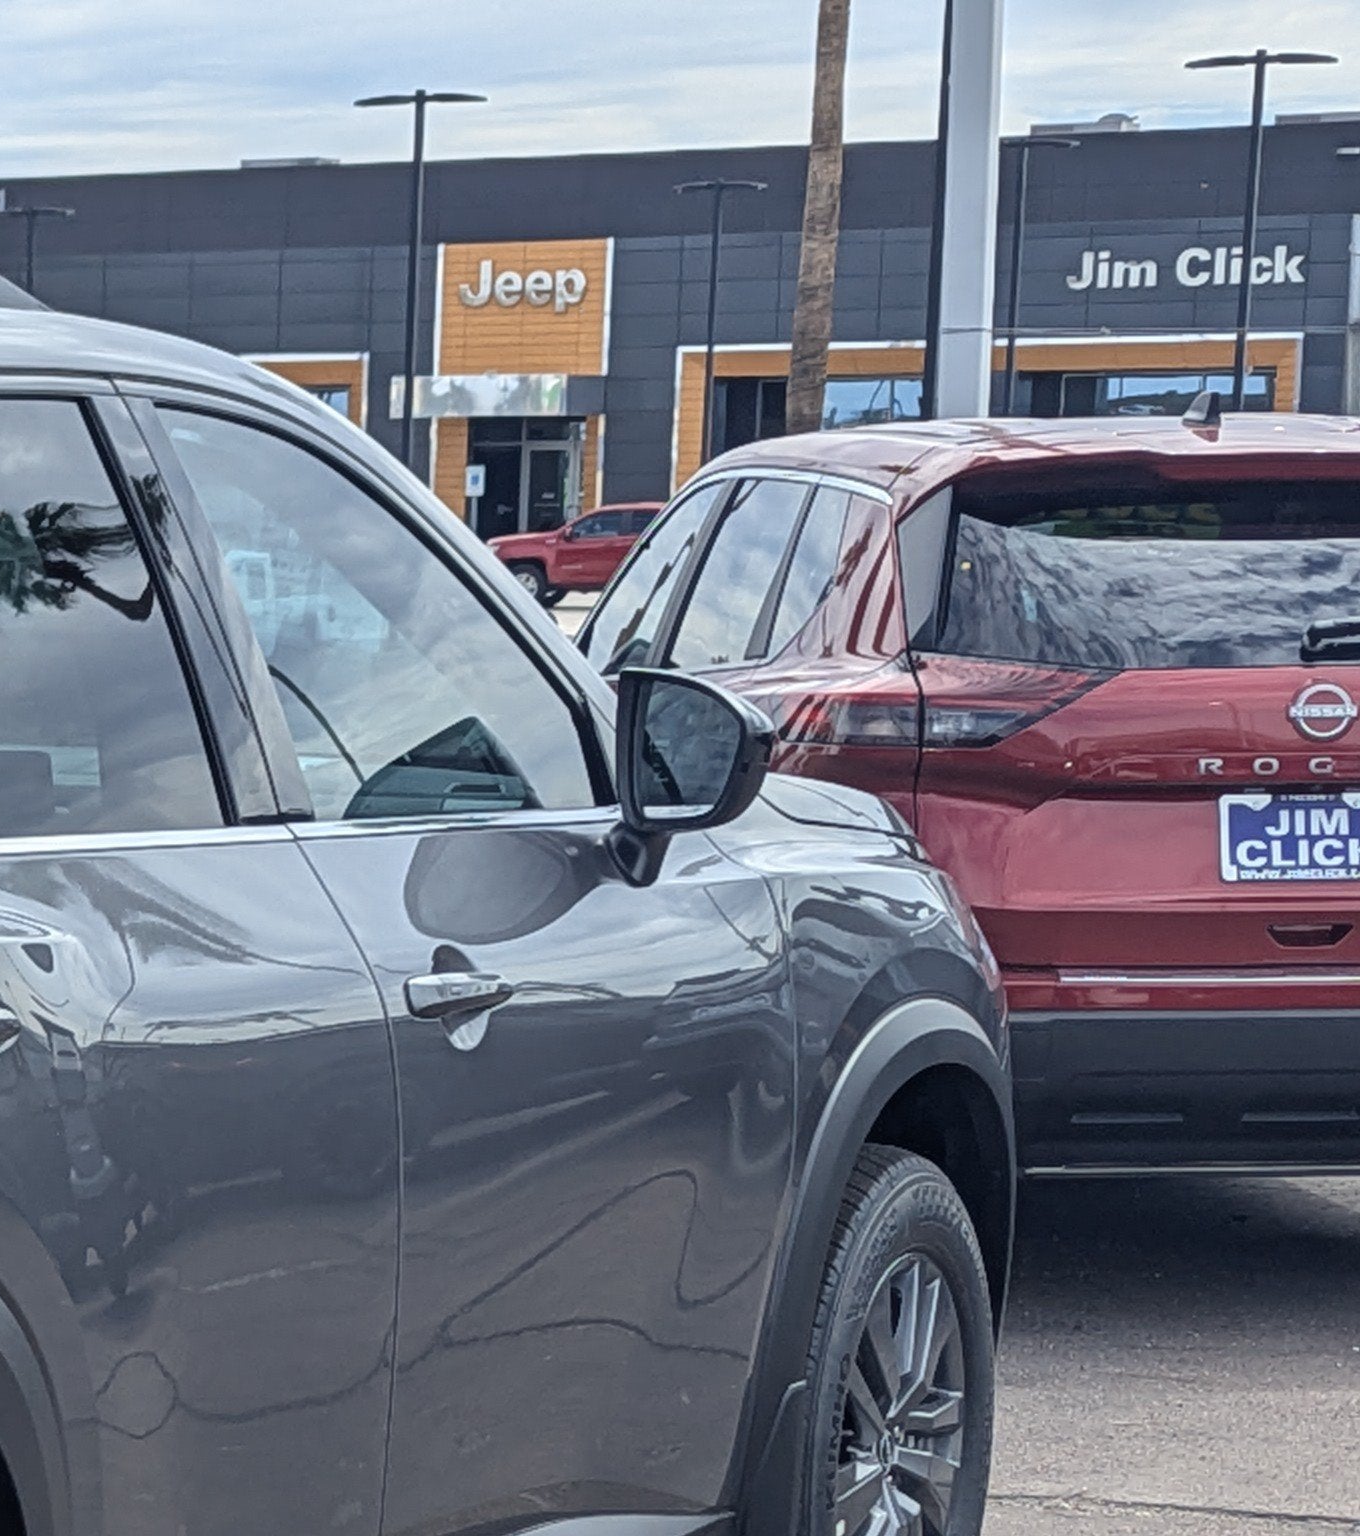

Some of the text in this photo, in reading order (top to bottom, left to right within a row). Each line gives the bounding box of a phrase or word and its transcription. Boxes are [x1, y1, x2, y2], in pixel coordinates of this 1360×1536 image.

[459, 259, 587, 313] Jeep
[1066, 245, 1306, 290] Jim Click
[1289, 704, 1358, 718] NISSAN
[1265, 808, 1350, 837] JIM
